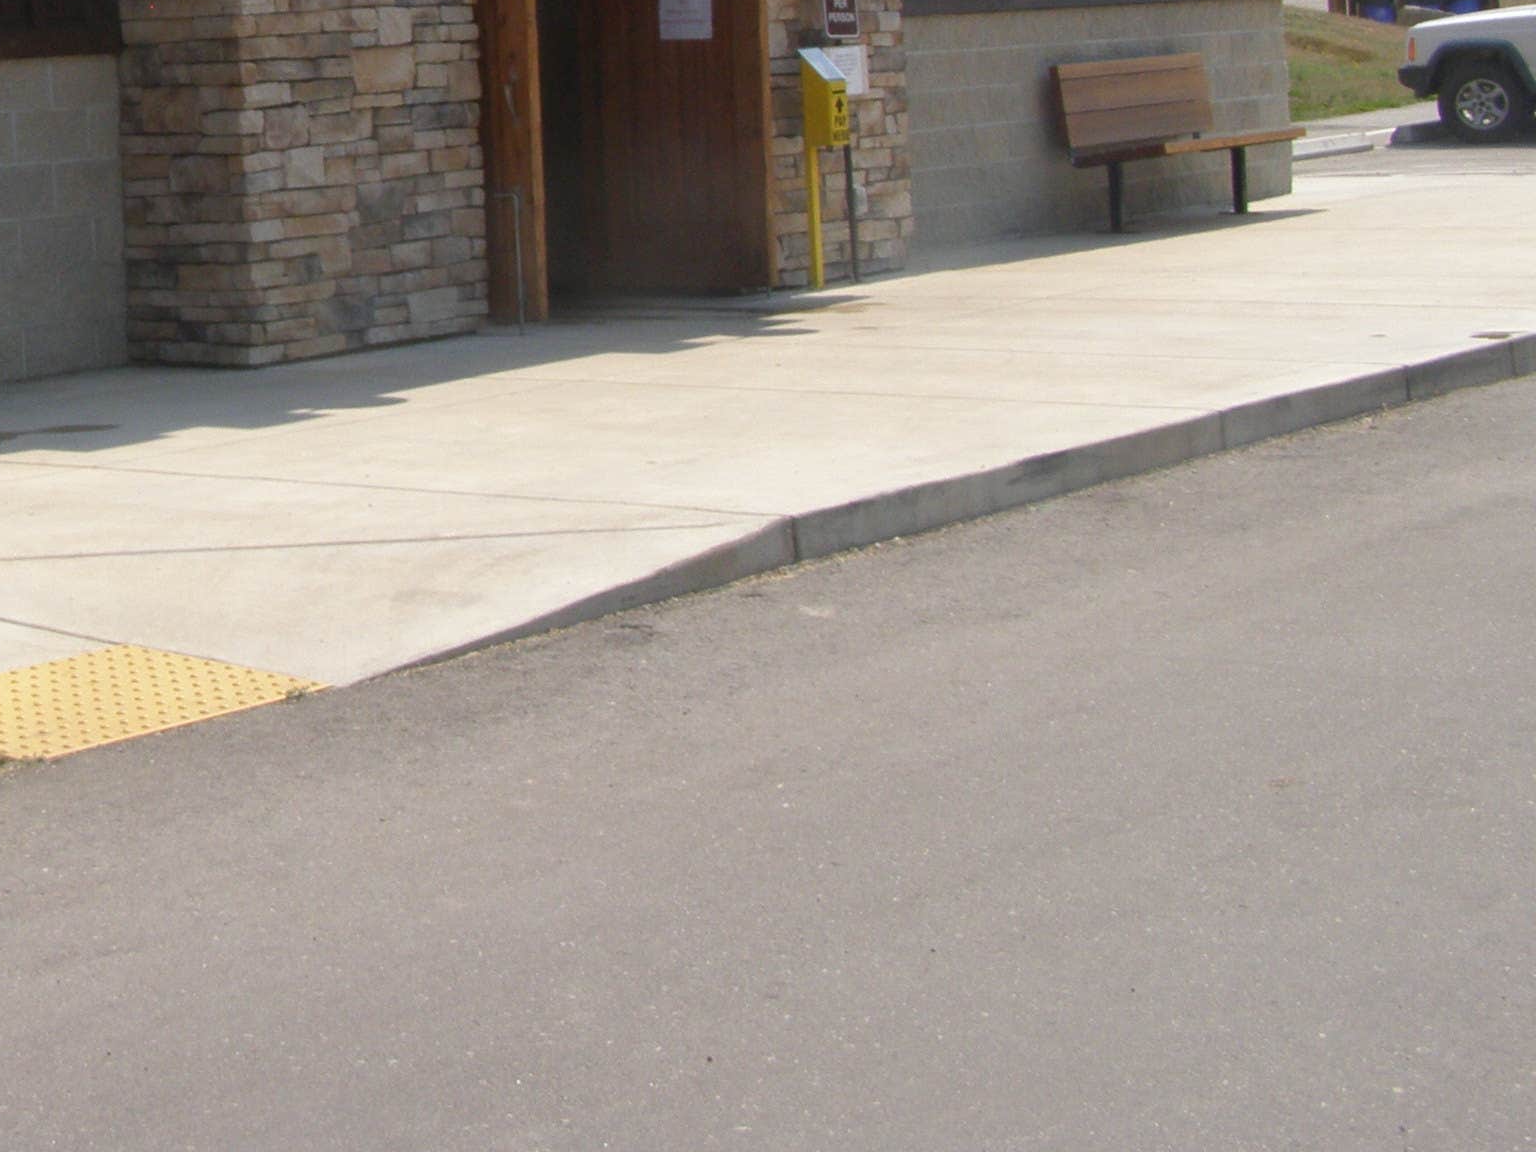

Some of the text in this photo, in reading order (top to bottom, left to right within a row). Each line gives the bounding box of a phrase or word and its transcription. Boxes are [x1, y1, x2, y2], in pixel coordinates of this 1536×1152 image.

[833, 0, 848, 8] PER
[828, 12, 856, 22] PERSON
[834, 115, 846, 128] PAY
